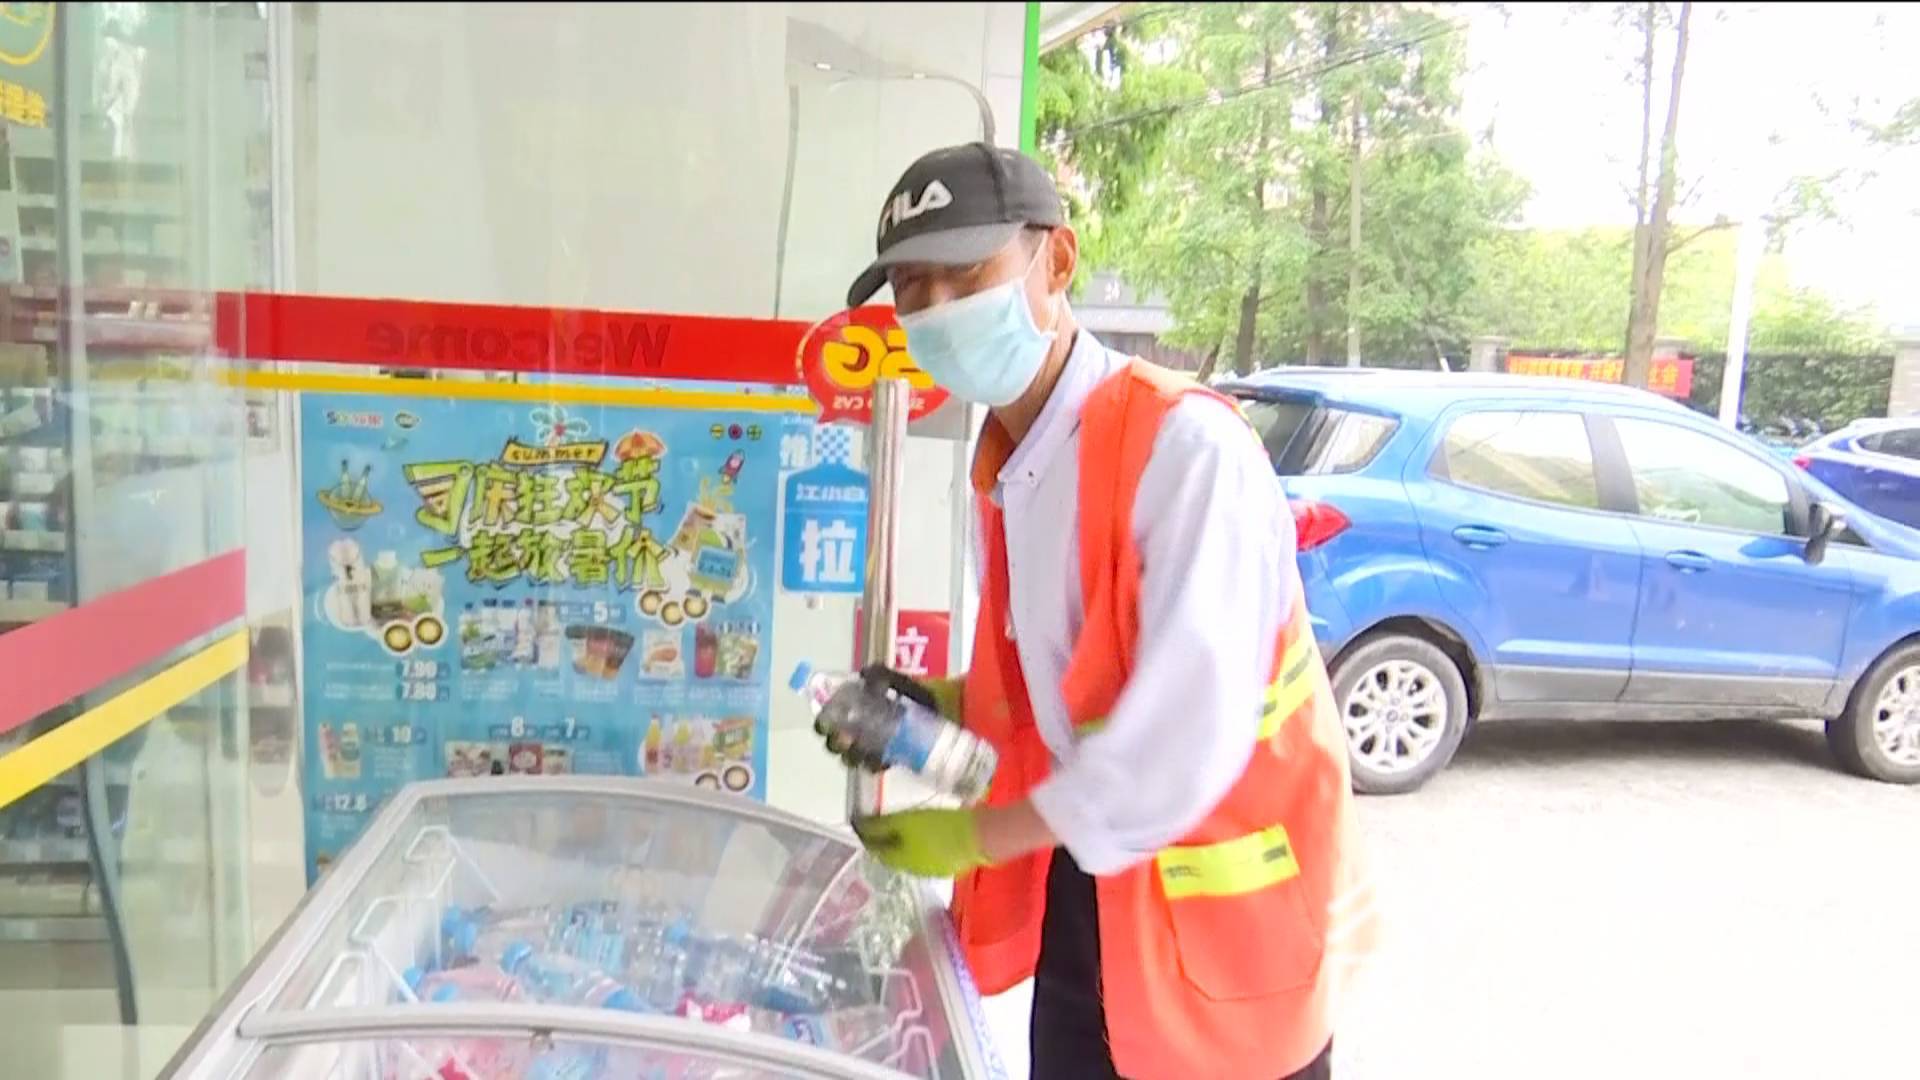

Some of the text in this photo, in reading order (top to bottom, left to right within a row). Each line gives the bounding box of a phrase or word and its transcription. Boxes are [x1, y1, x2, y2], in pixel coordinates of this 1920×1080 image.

[510, 447, 597, 461] summer
[796, 483, 869, 502] 江小白
[799, 518, 857, 583] 拉
